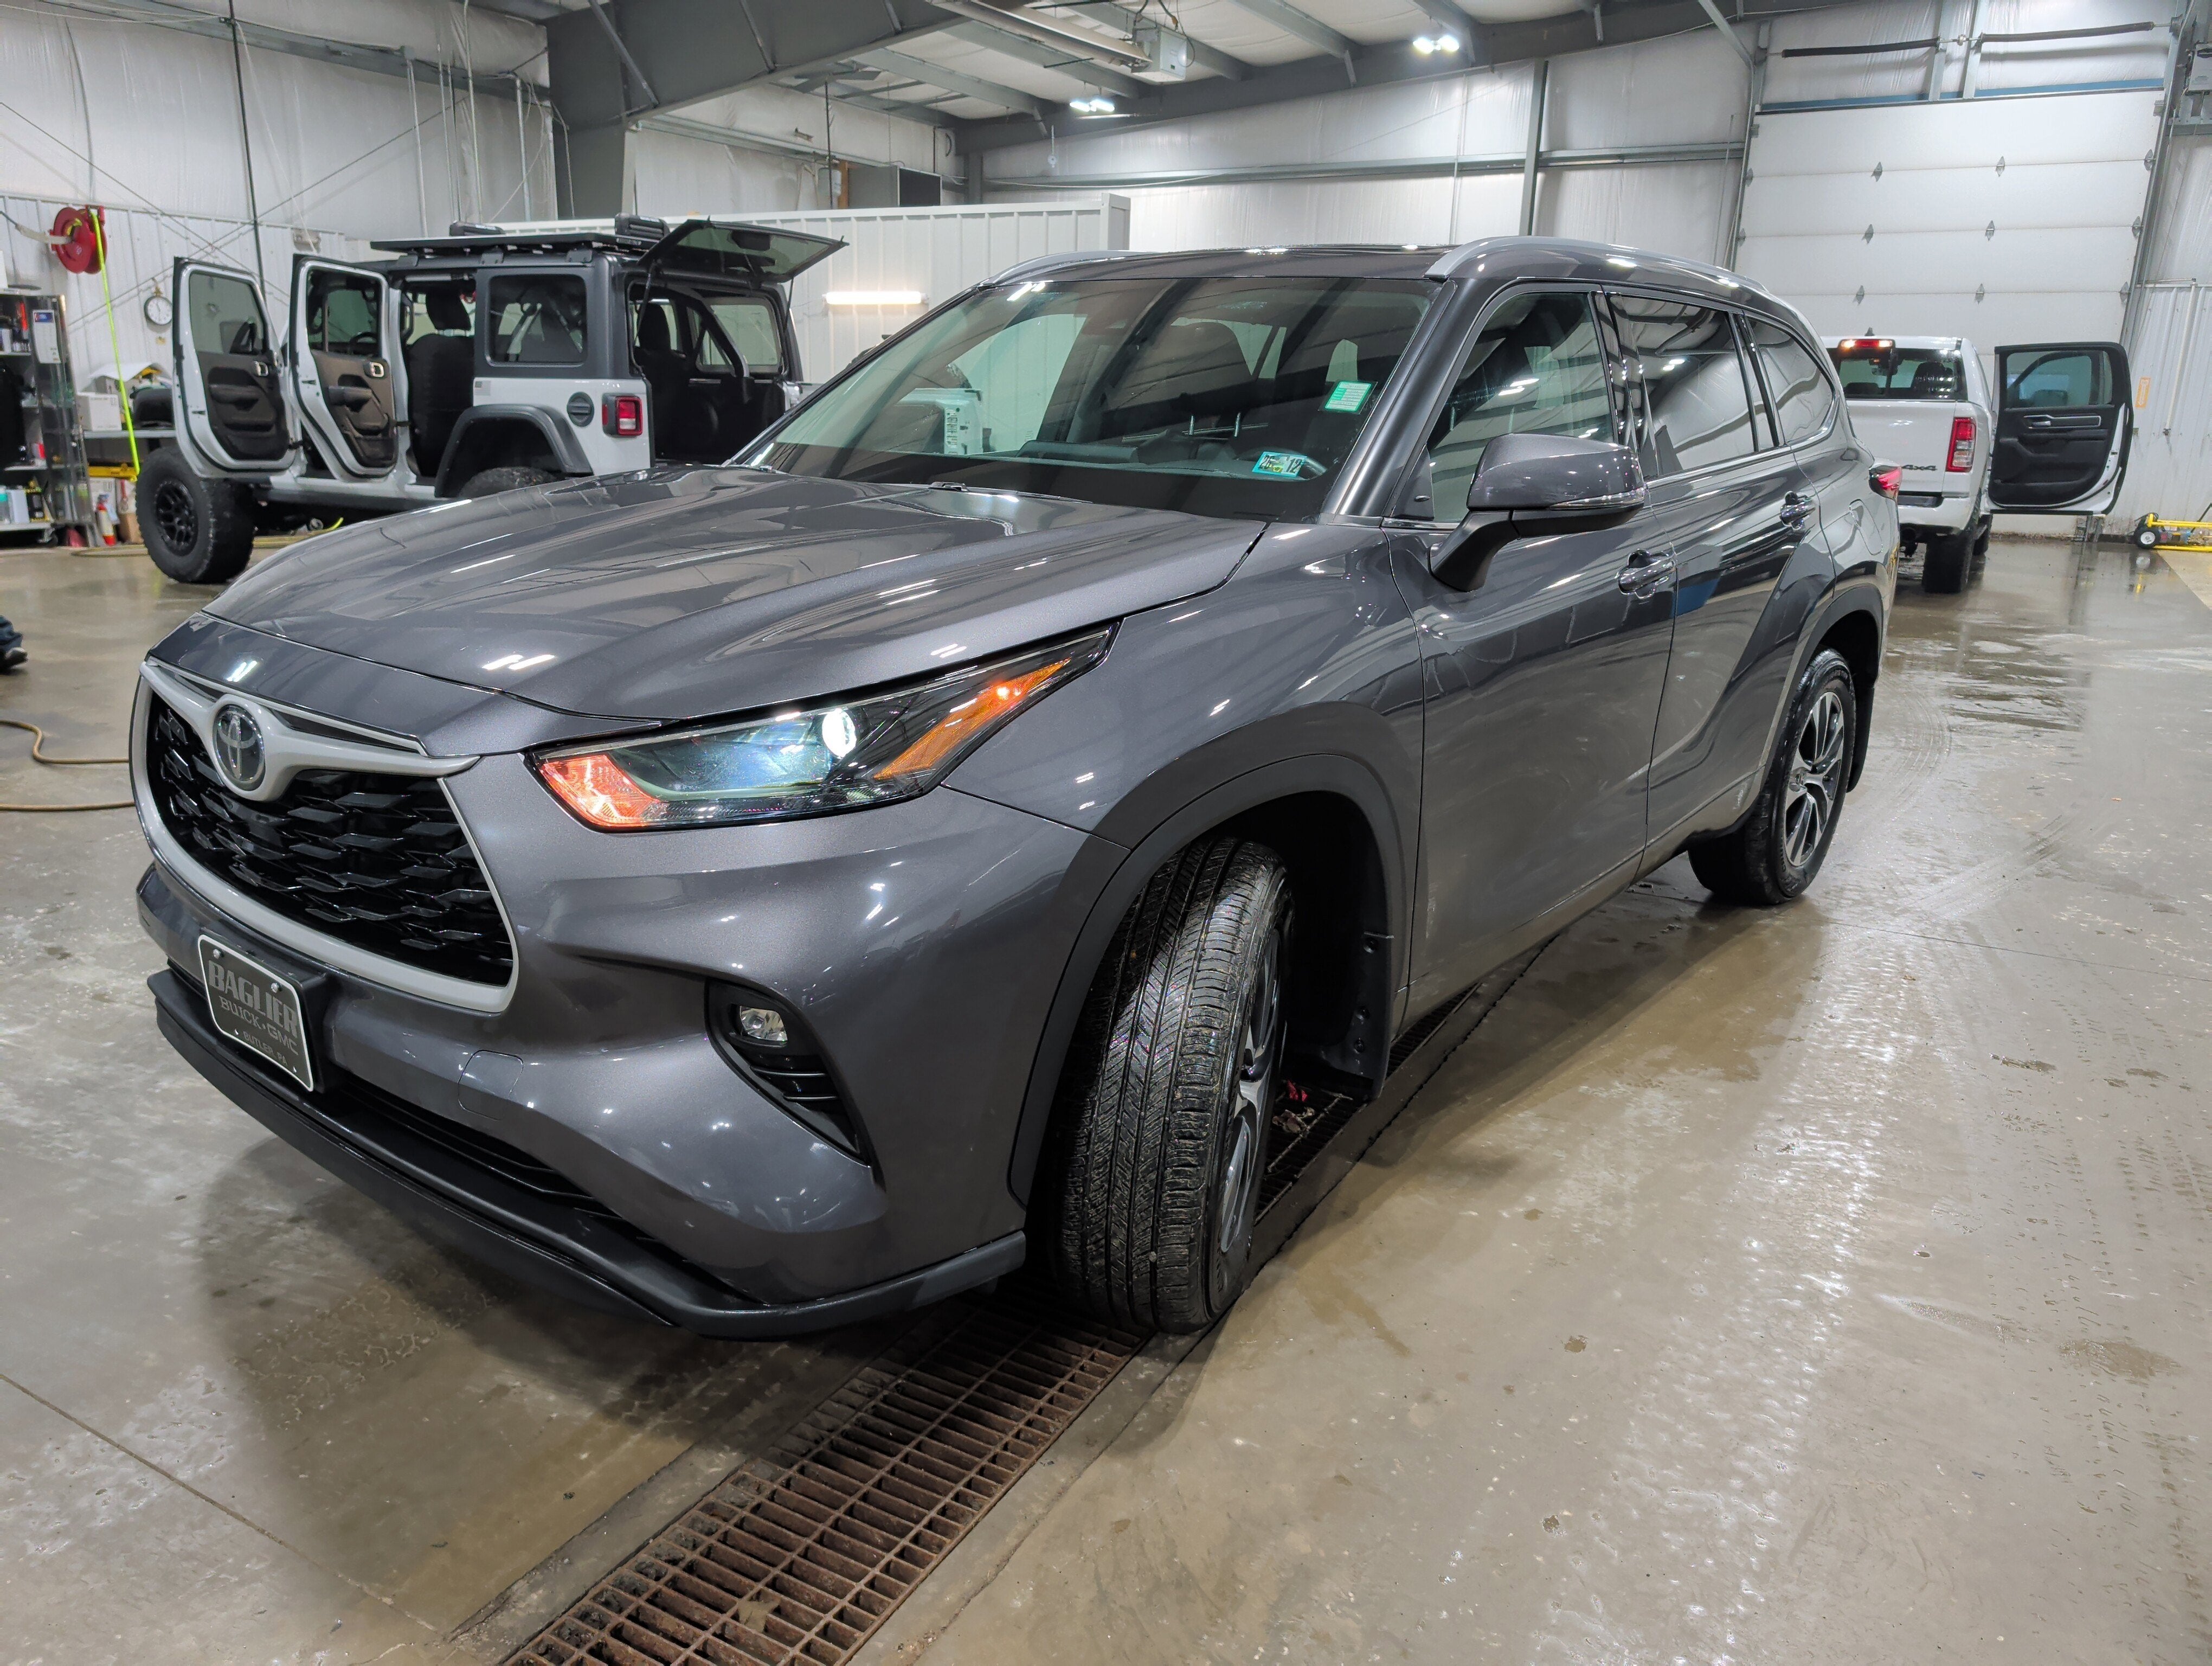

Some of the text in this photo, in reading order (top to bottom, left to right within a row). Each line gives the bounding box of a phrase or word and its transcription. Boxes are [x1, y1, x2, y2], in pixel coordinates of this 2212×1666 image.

[1284, 458, 1303, 473] 12
[208, 959, 298, 1039] BAGLIER
[218, 996, 299, 1056] BUICK GMC
[276, 1052, 287, 1066] PA
